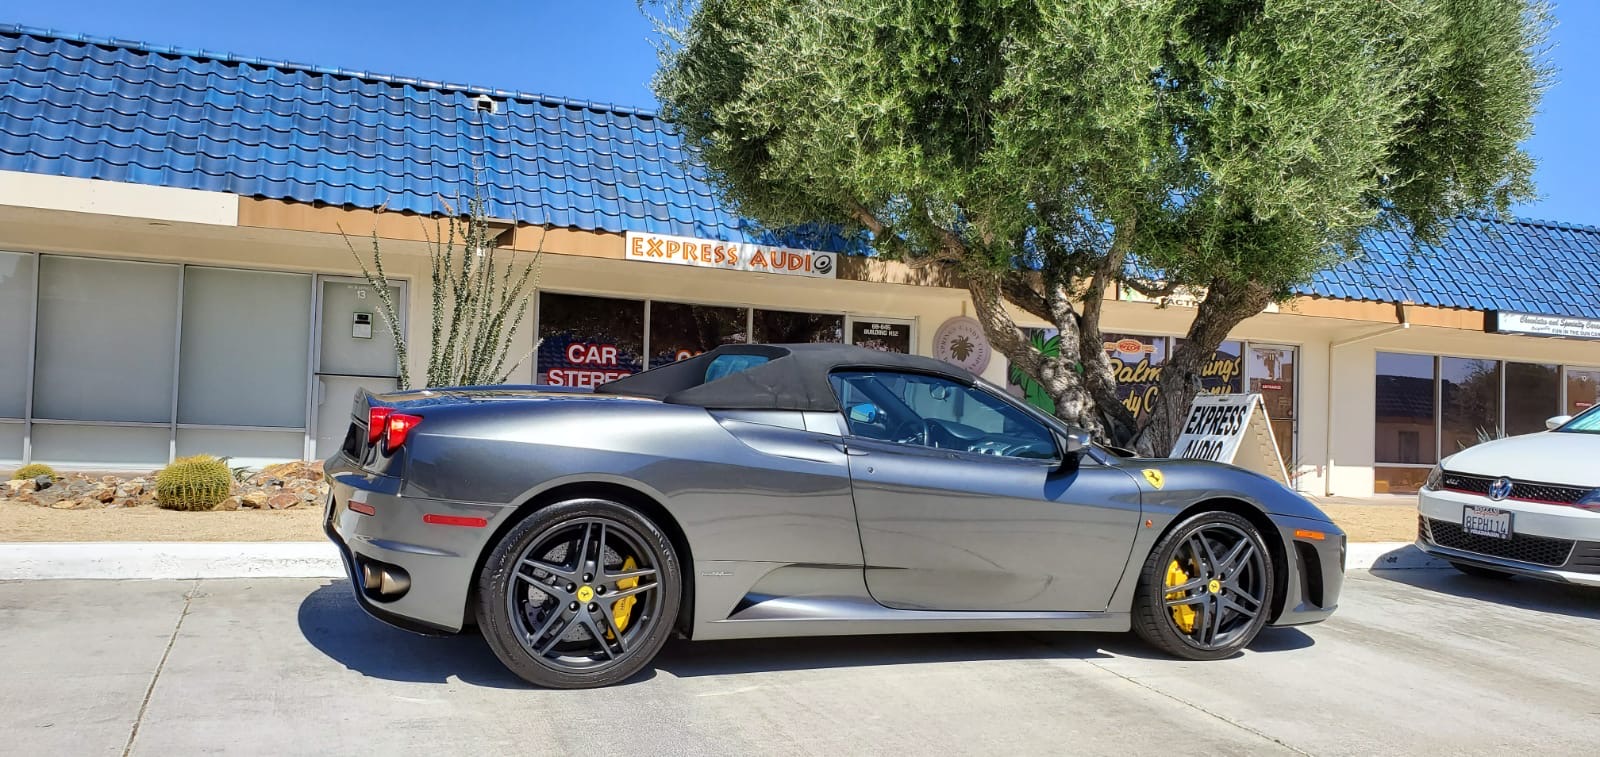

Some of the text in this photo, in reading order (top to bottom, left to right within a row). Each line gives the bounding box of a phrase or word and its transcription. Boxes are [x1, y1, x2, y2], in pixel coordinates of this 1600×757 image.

[631, 236, 738, 266] EXPRESS
[357, 290, 366, 299] 13
[863, 328, 888, 336] BUILDING
[567, 344, 617, 365] CAR
[1184, 405, 1248, 436] EXPRESS
